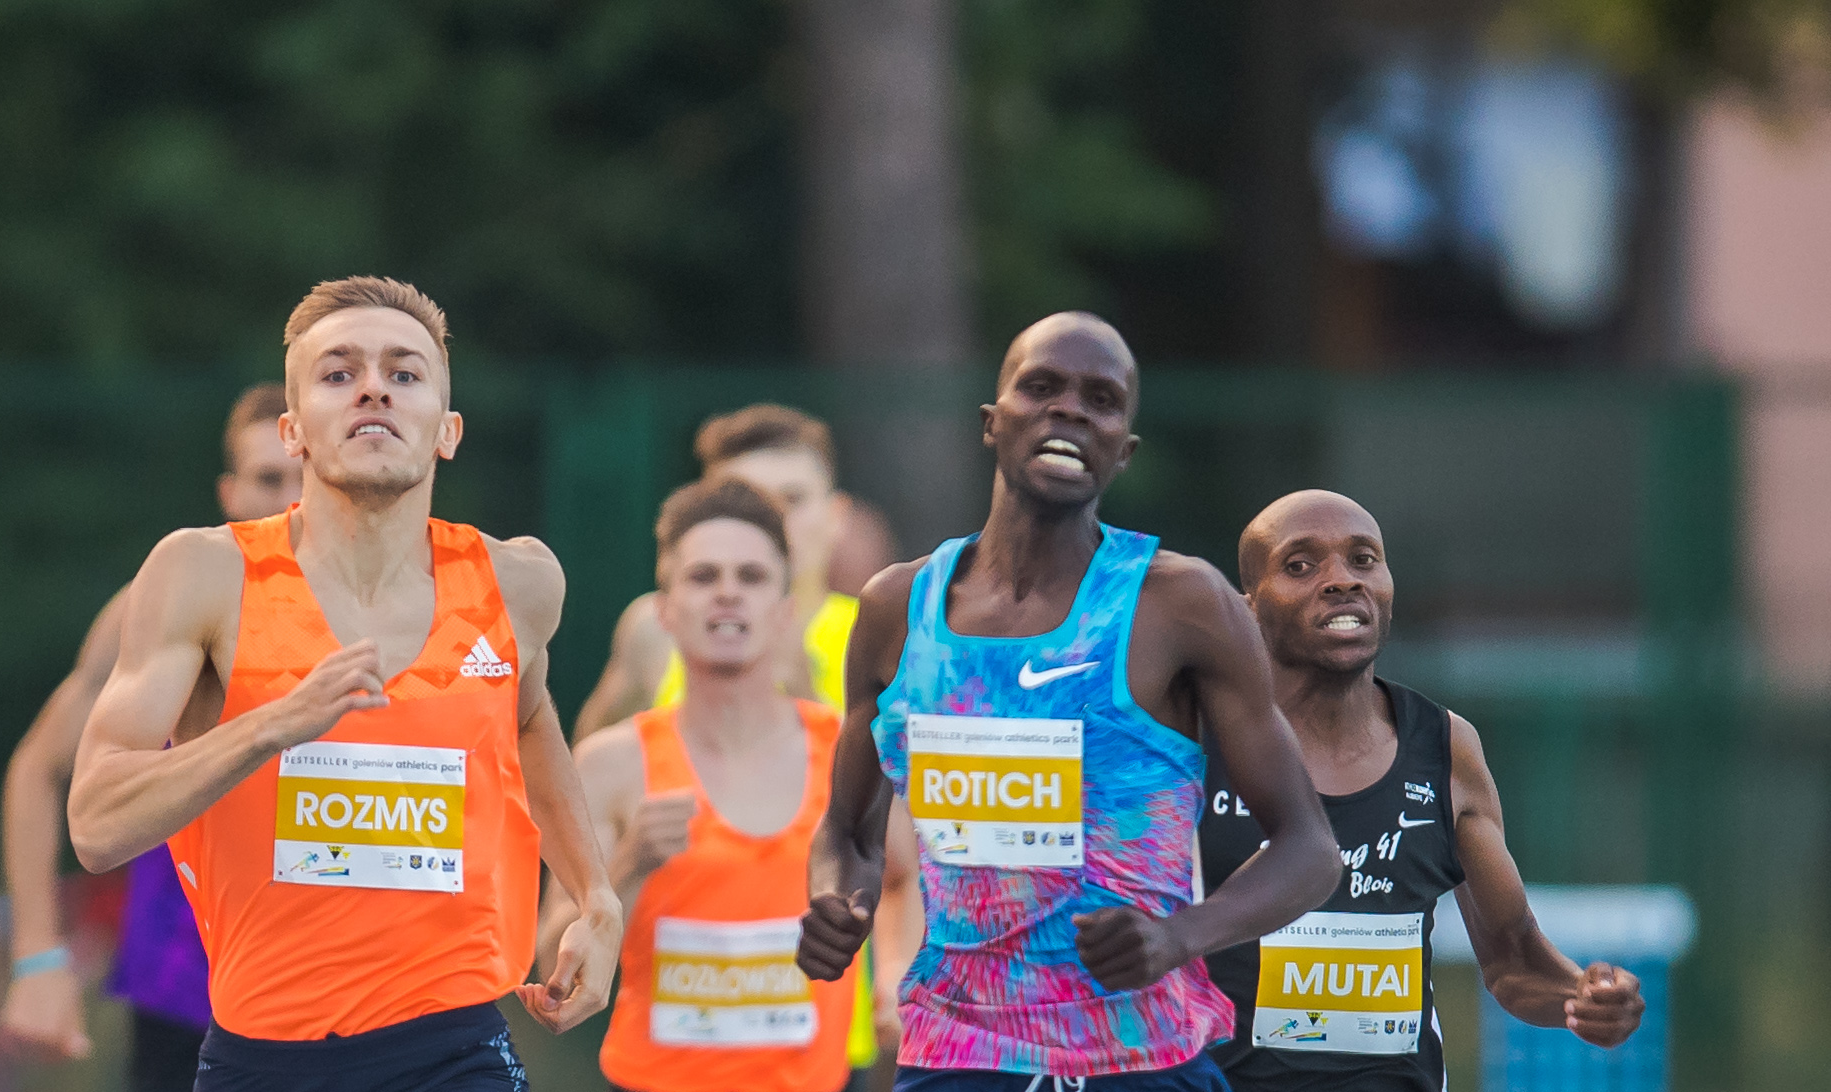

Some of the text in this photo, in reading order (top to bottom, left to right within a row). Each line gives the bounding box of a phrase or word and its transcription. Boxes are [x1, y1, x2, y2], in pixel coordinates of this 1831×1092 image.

[460, 661, 512, 677] adidas
[1005, 734, 1050, 743] athletics
[1053, 735, 1079, 745] park
[284, 755, 348, 767] BESTSELLER
[396, 760, 438, 771] athletics
[440, 762, 463, 773] park
[923, 768, 1063, 809] ROTICH
[294, 791, 448, 834] ROZMYS
[1336, 830, 1402, 870] ng 41
[1350, 871, 1394, 898] Blois
[1331, 926, 1373, 938] goleniów
[1282, 962, 1409, 997] MUTAI
